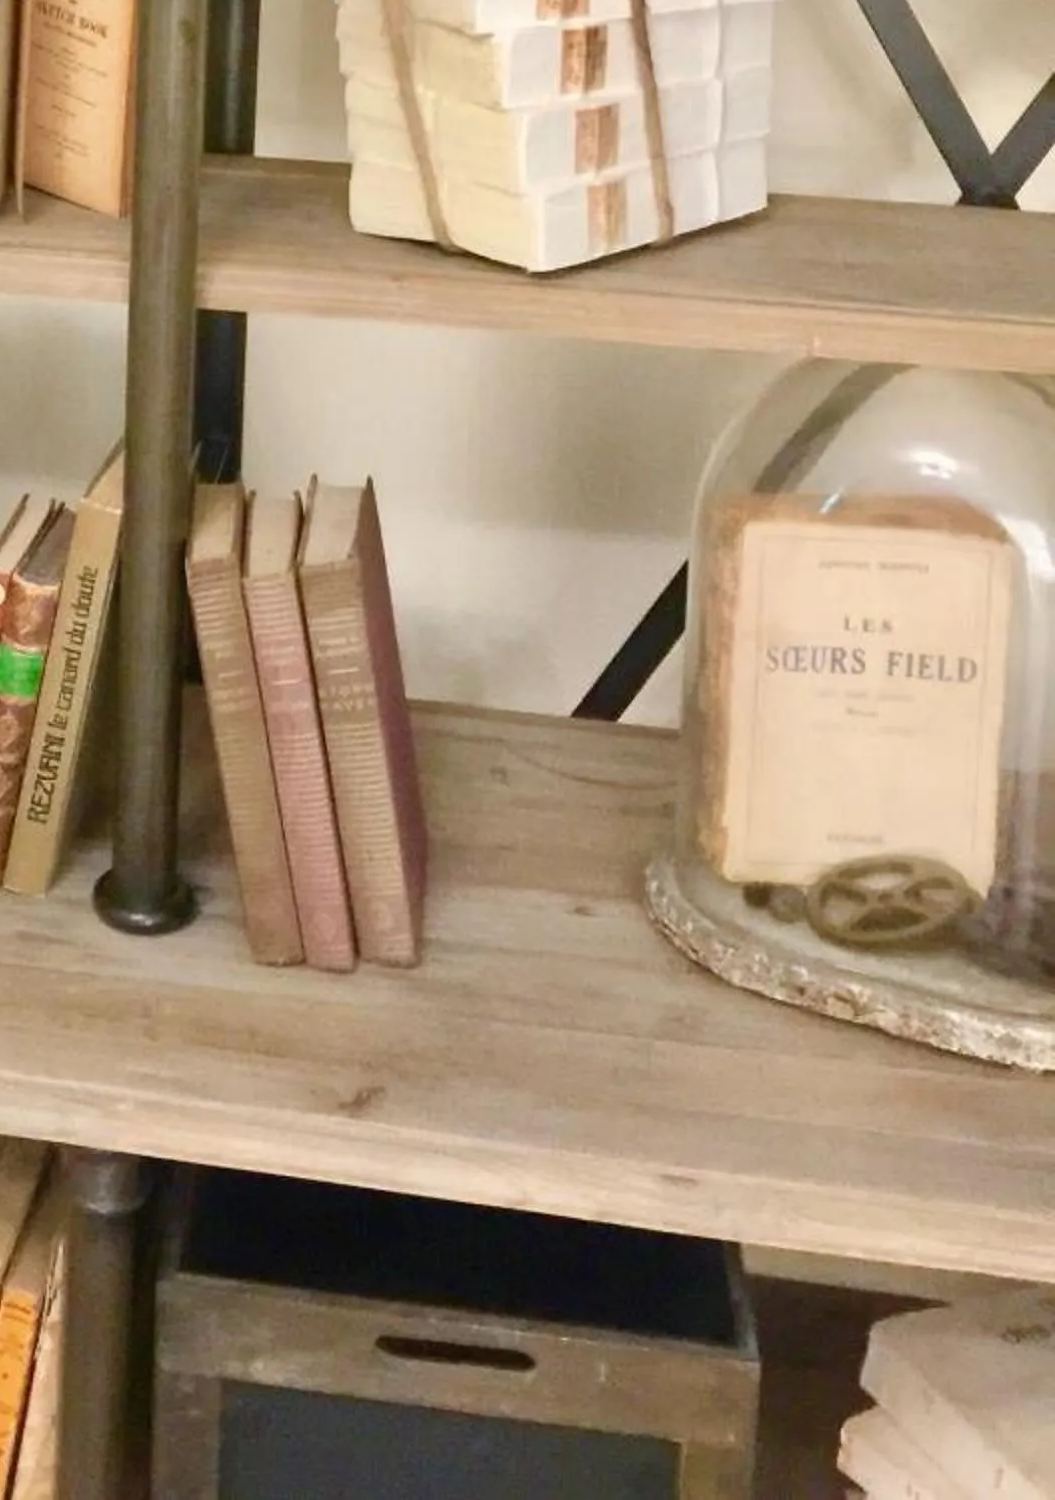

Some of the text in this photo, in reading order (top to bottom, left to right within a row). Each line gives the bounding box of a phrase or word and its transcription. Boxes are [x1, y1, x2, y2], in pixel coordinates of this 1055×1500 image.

[72, 566, 99, 620] doute
[65, 621, 88, 646] du
[844, 615, 893, 633] LES
[56, 648, 82, 712] canard
[765, 645, 979, 684] SŒURS FIELD
[48, 712, 68, 732] le
